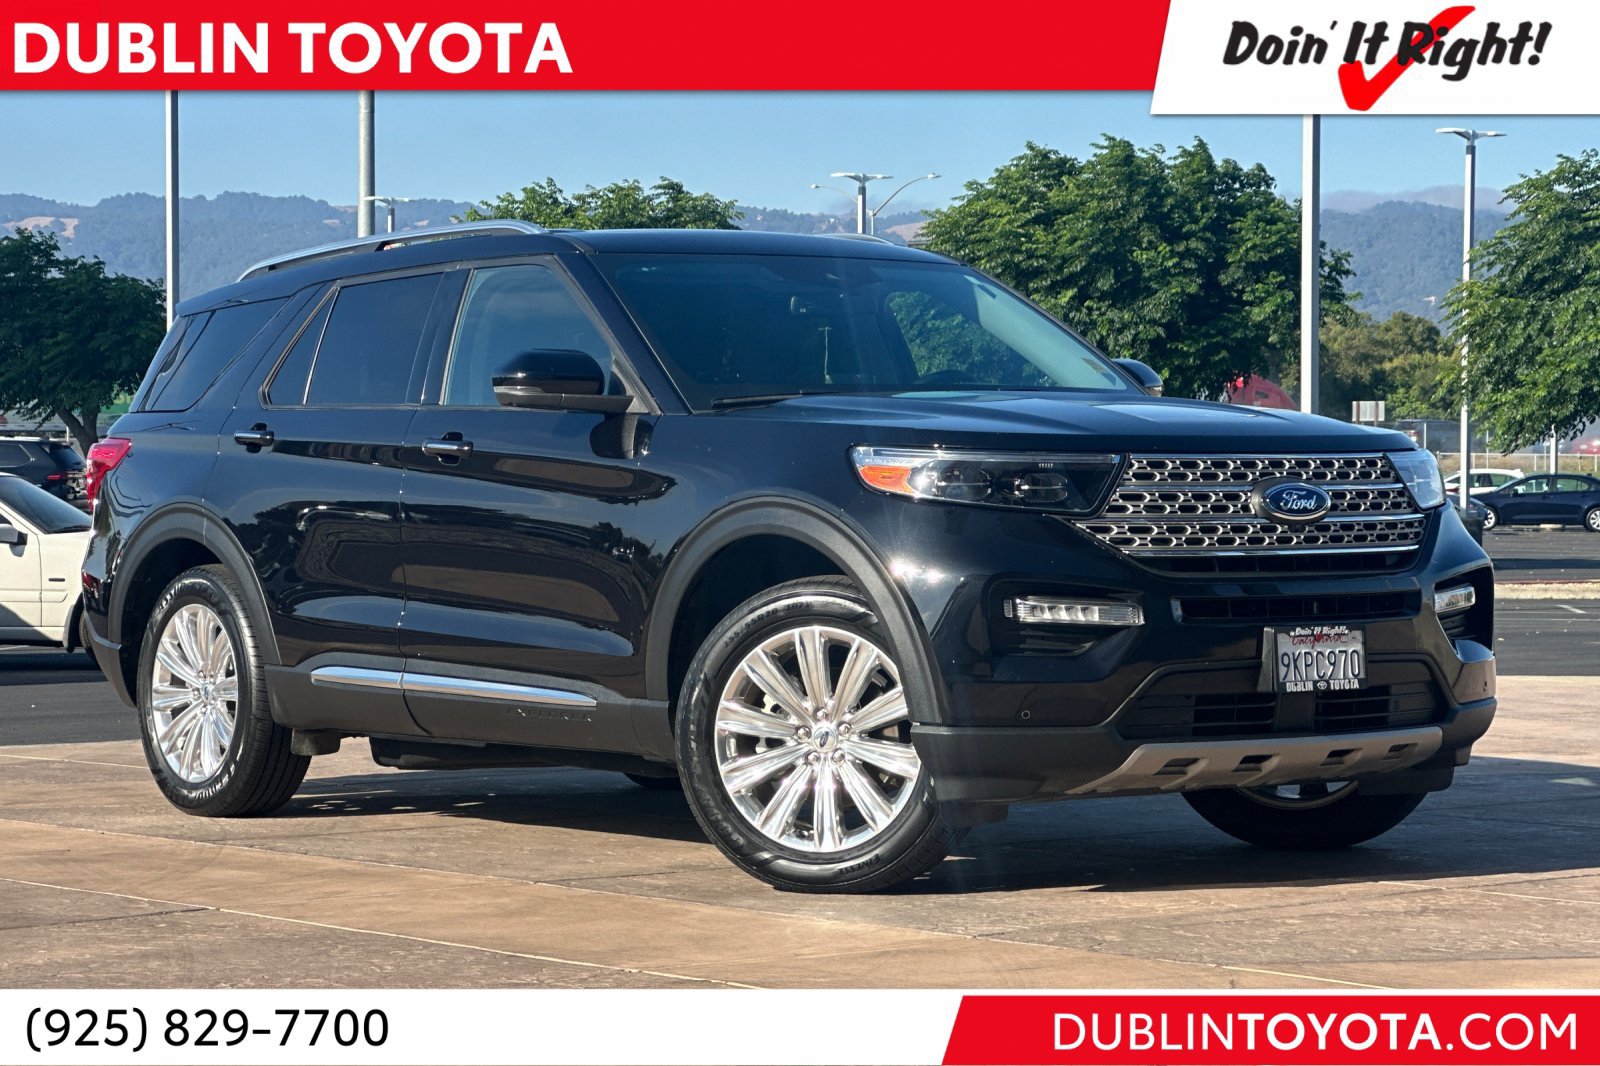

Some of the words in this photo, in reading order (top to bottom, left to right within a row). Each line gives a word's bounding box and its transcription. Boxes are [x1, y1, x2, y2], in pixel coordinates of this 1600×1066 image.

[1280, 489, 1317, 511] Ford
[1280, 649, 1361, 681] 9KPC970
[1286, 680, 1314, 692] DUBLIN
[1329, 678, 1360, 690] TOYOTA
